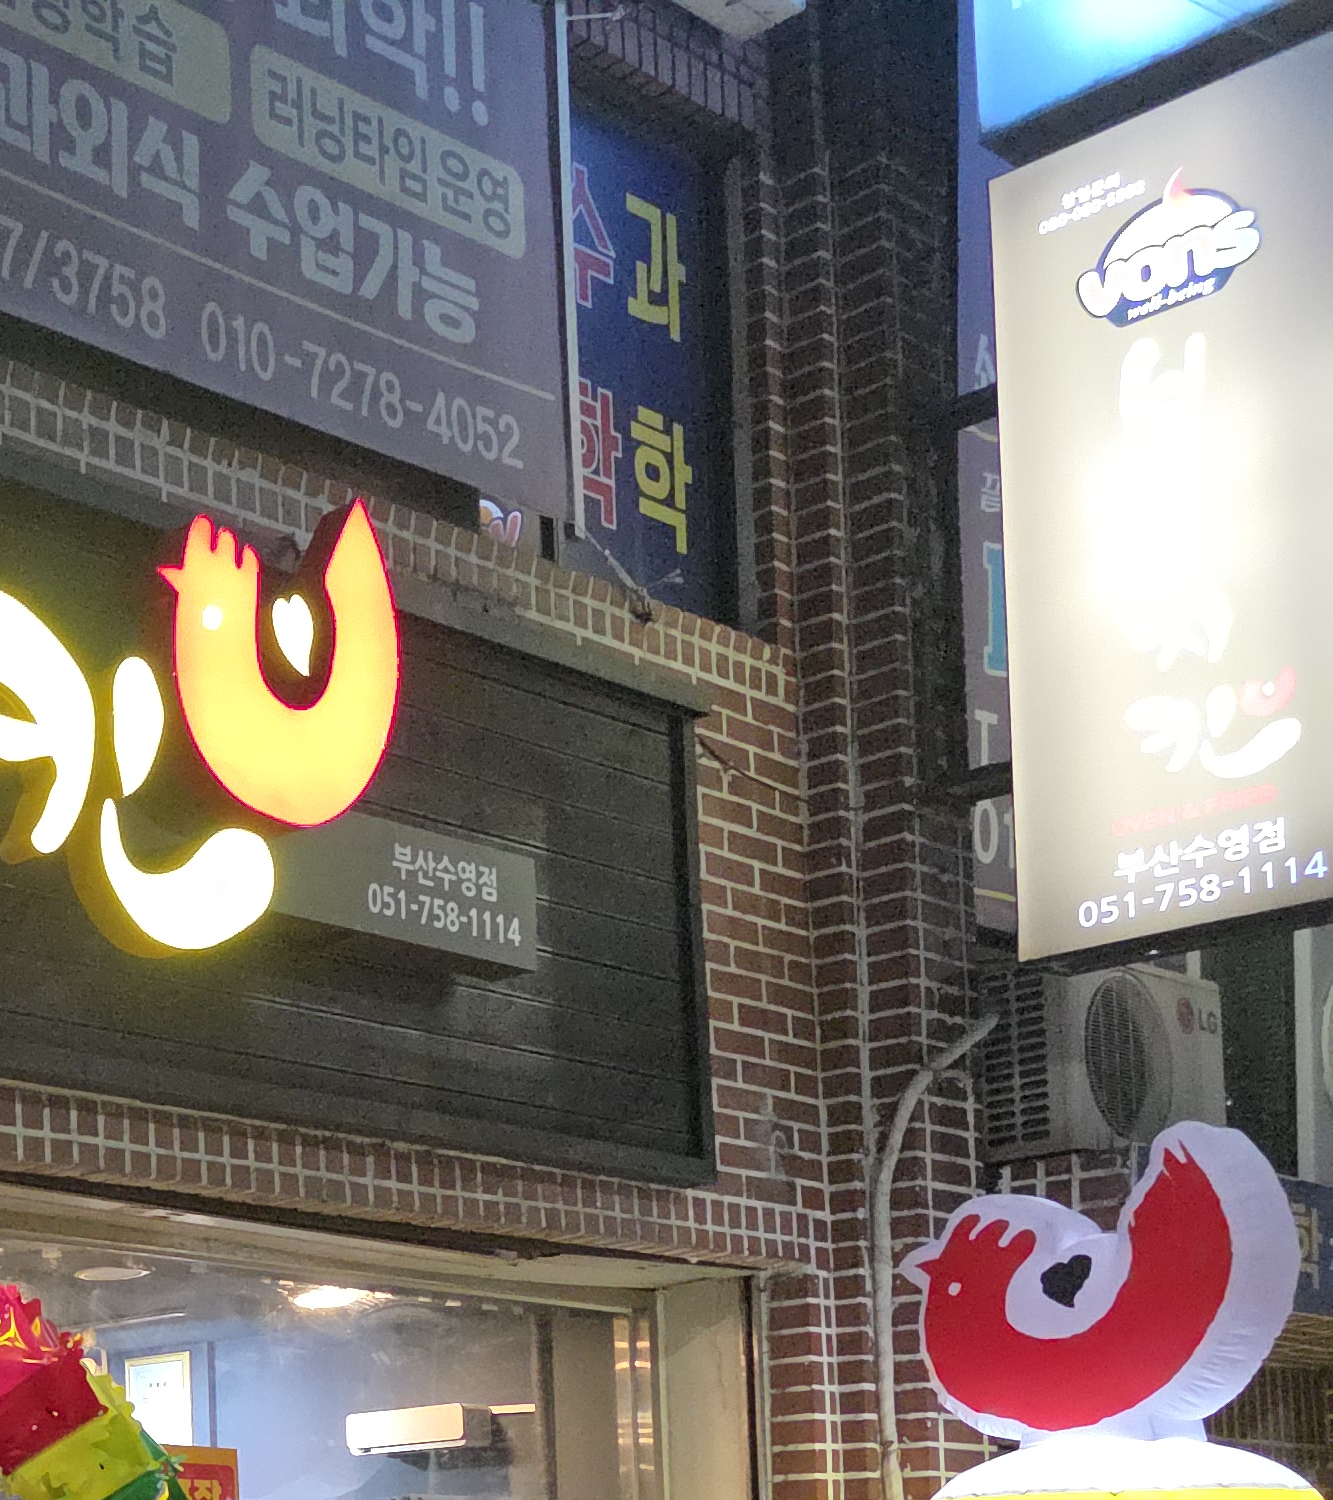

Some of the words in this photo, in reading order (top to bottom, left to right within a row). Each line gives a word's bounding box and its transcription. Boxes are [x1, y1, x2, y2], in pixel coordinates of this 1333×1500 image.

[266, 66, 511, 241] 러닝타임운영
[226, 159, 480, 345] 수업가능
[1076, 209, 1261, 318] vons
[199, 301, 525, 470] 010-7278-4052
[626, 192, 693, 555] 과학
[392, 841, 498, 902] 부산수영점
[1077, 850, 1329, 929] 051-758-1114
[1113, 816, 1287, 884] 부산수영점
[367, 882, 522, 947] 051-758-1114
[1197, 1008, 1219, 1034] LG
